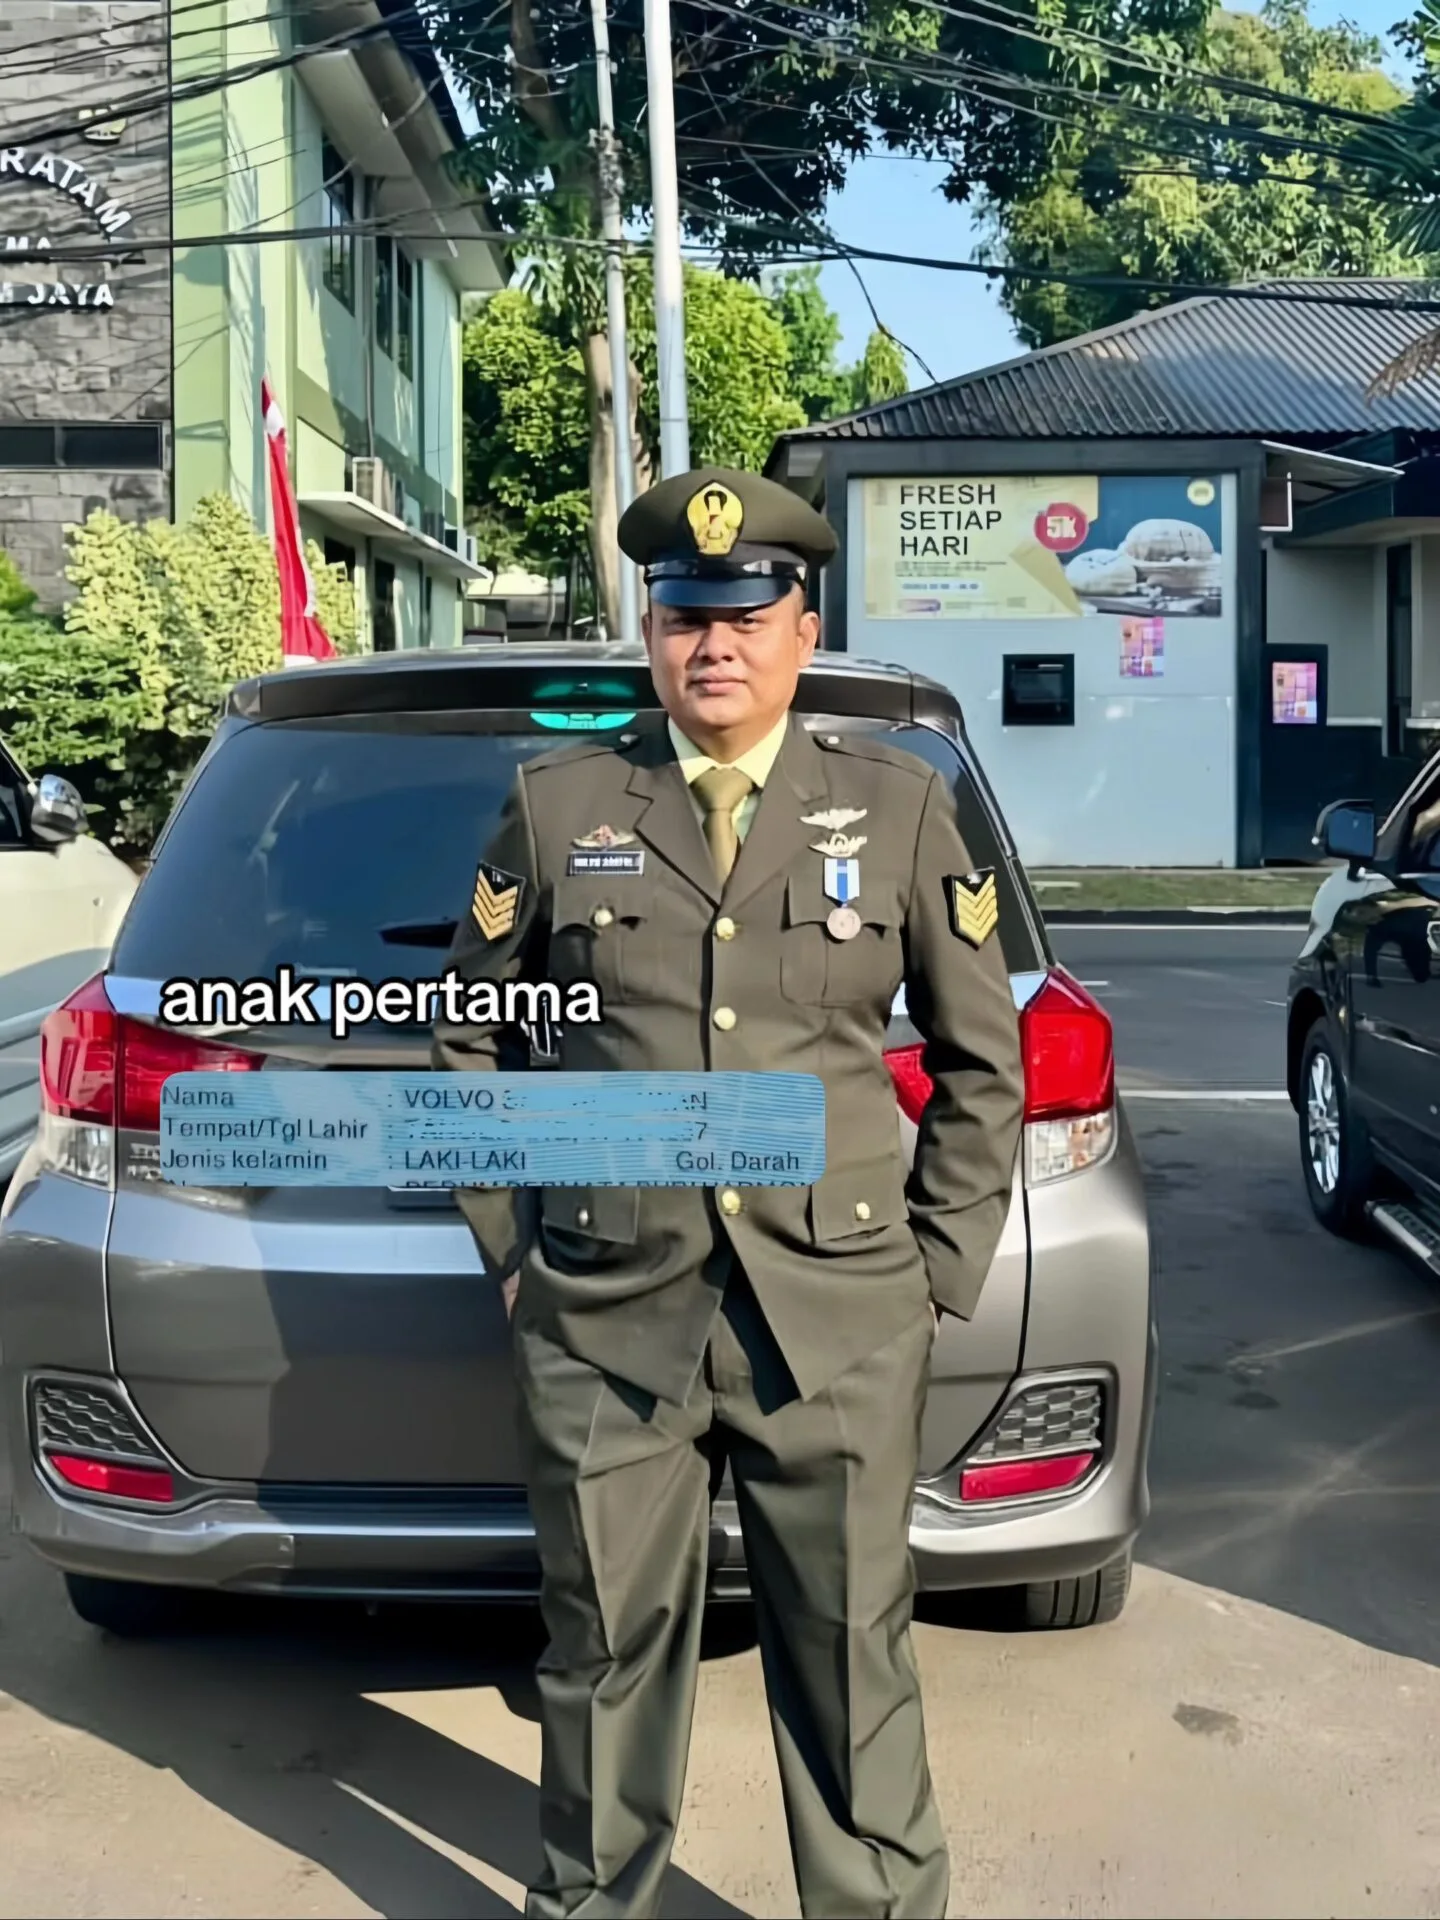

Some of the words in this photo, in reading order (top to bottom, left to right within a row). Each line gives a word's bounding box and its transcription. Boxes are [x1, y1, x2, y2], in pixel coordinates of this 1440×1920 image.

[0, 147, 132, 246] RATAM
[27, 282, 114, 306] JAYA
[900, 484, 995, 505] FRESH
[900, 510, 1002, 531] SETIAP
[900, 536, 968, 556] HARI
